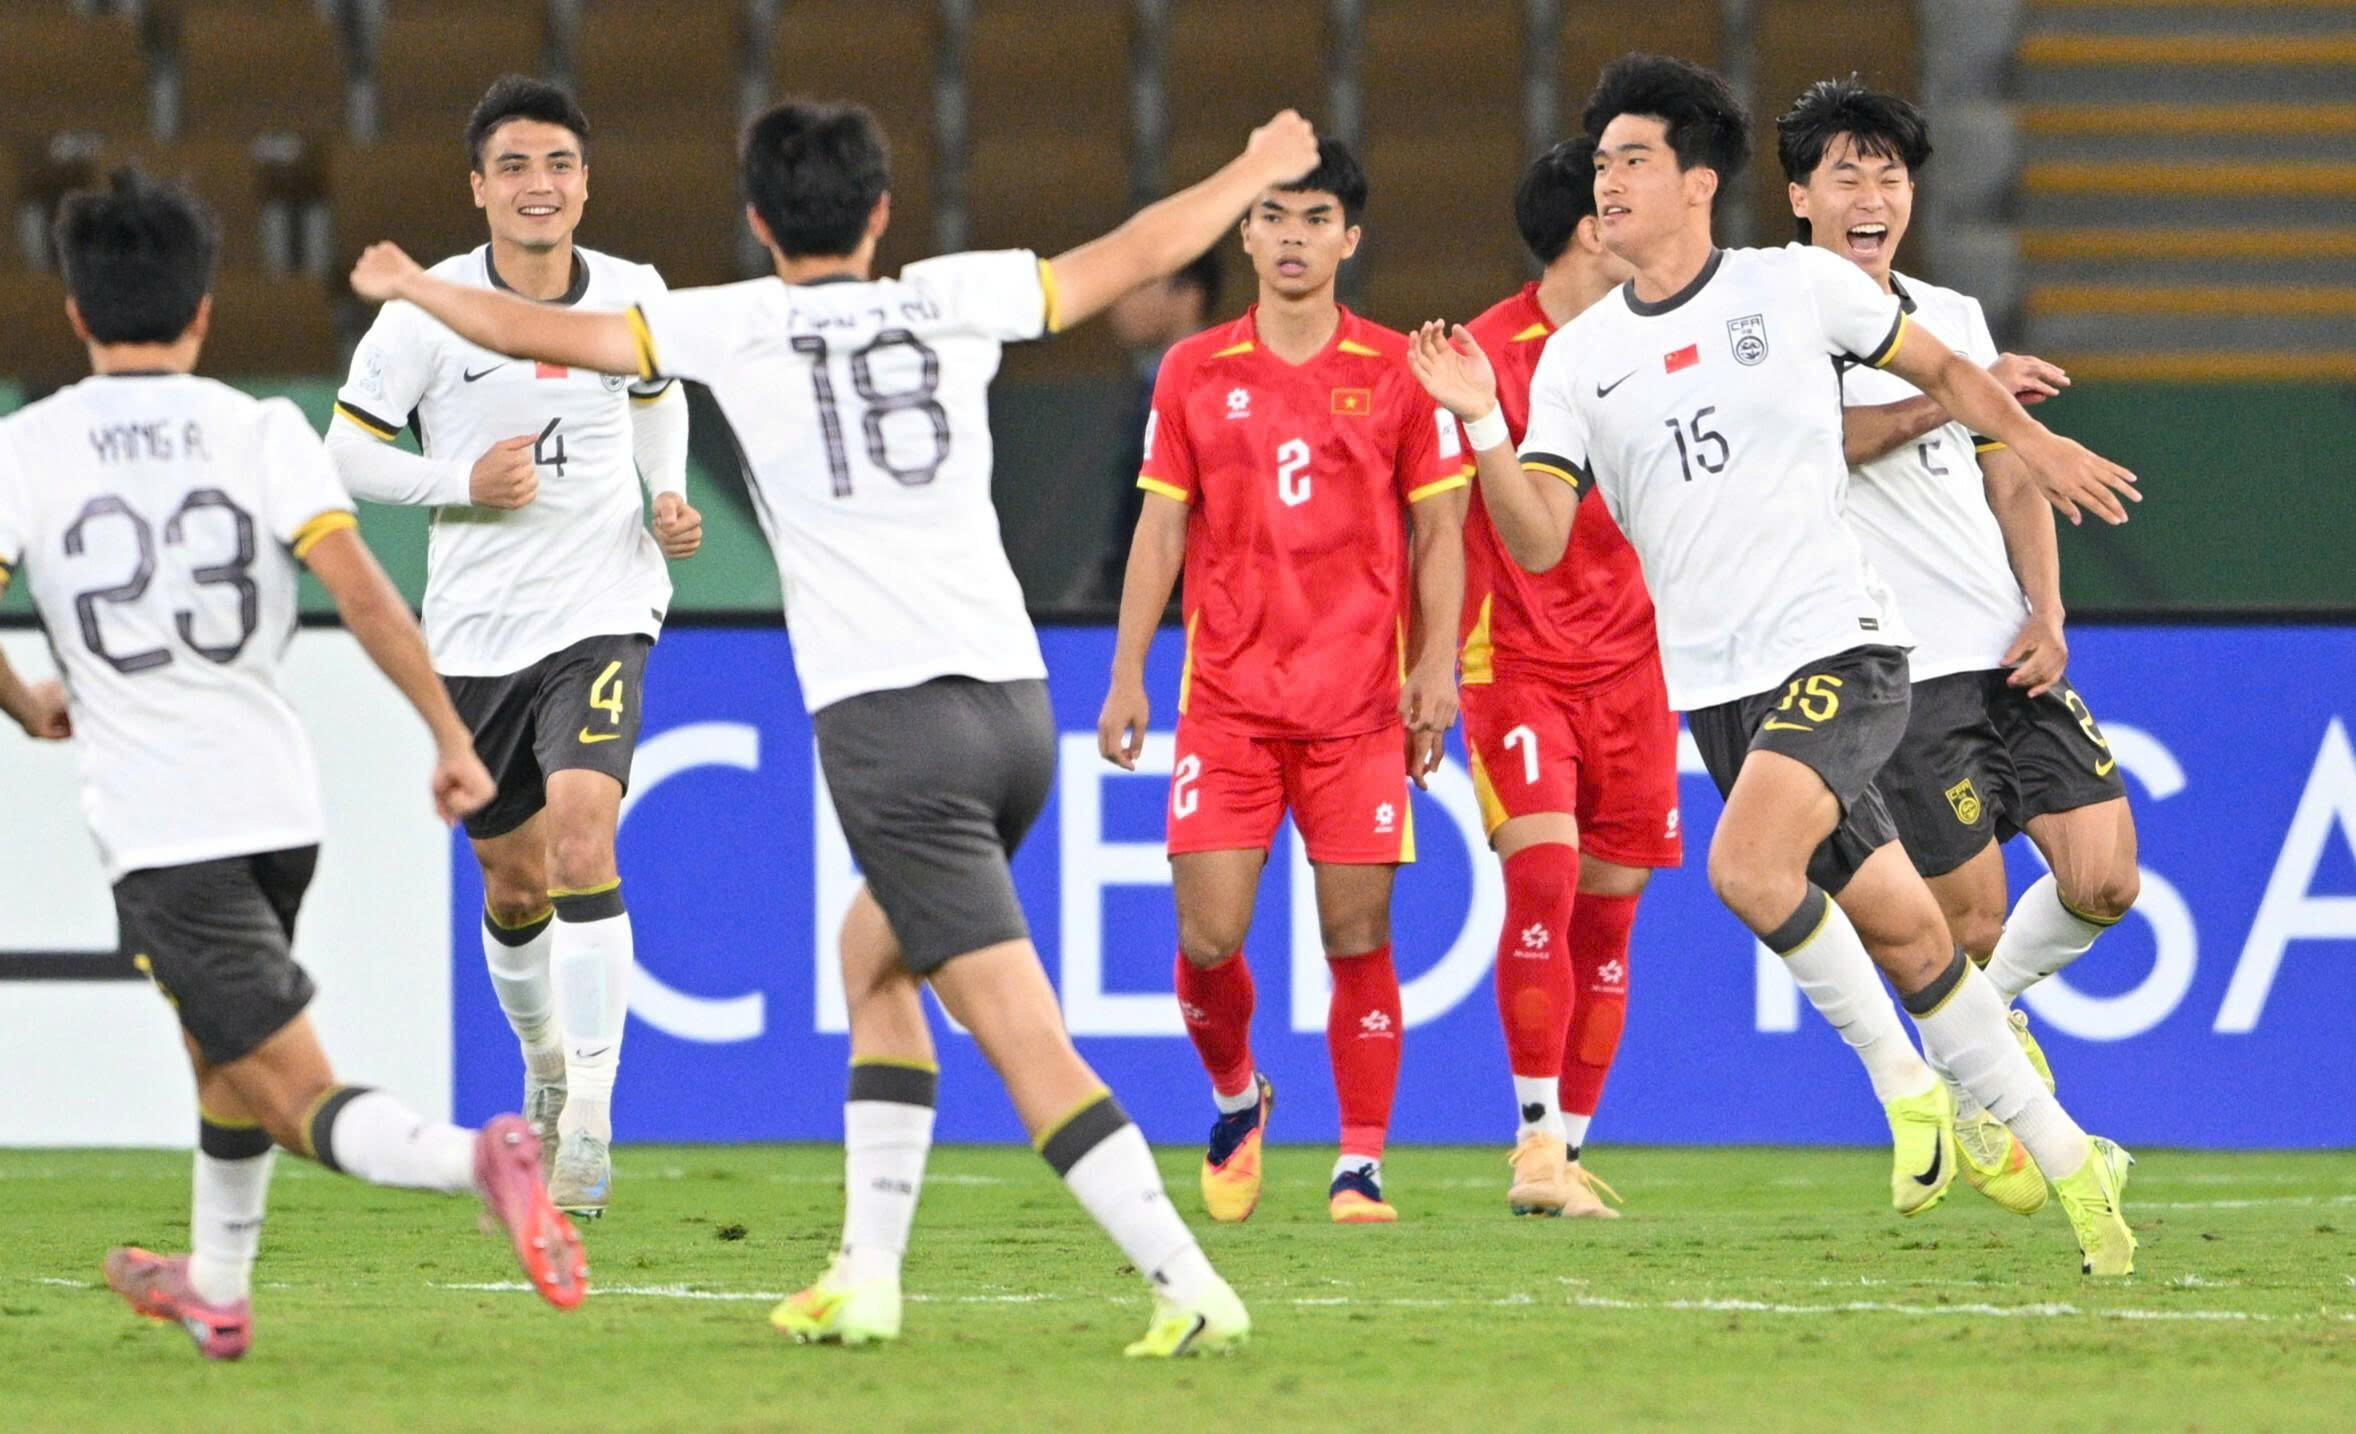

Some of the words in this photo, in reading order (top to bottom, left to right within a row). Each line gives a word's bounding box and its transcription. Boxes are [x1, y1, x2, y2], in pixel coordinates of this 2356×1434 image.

[792, 327, 951, 498] 18
[1664, 405, 1731, 483] 15
[534, 417, 567, 478] 4
[1277, 438, 1312, 507] 2
[64, 487, 257, 675] 23
[588, 660, 624, 725] 4
[1777, 674, 1844, 723] 15
[1173, 754, 1201, 820] 2
